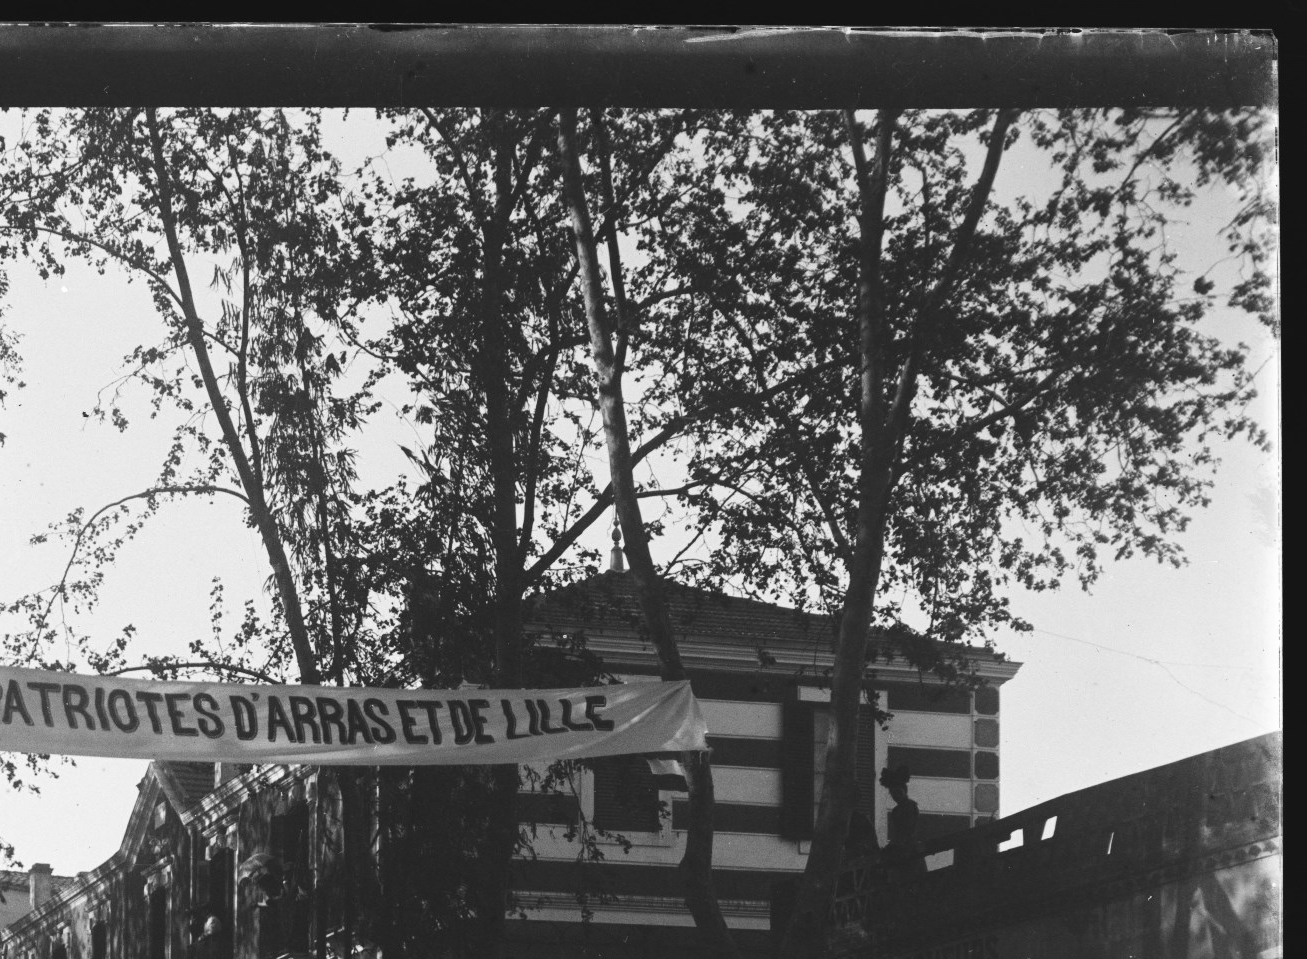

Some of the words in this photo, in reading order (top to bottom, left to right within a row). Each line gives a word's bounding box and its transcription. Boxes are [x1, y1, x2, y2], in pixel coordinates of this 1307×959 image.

[229, 692, 396, 745] D'ARRAS
[396, 699, 444, 745] ET
[446, 699, 495, 745] DE
[500, 695, 615, 740] LILLE
